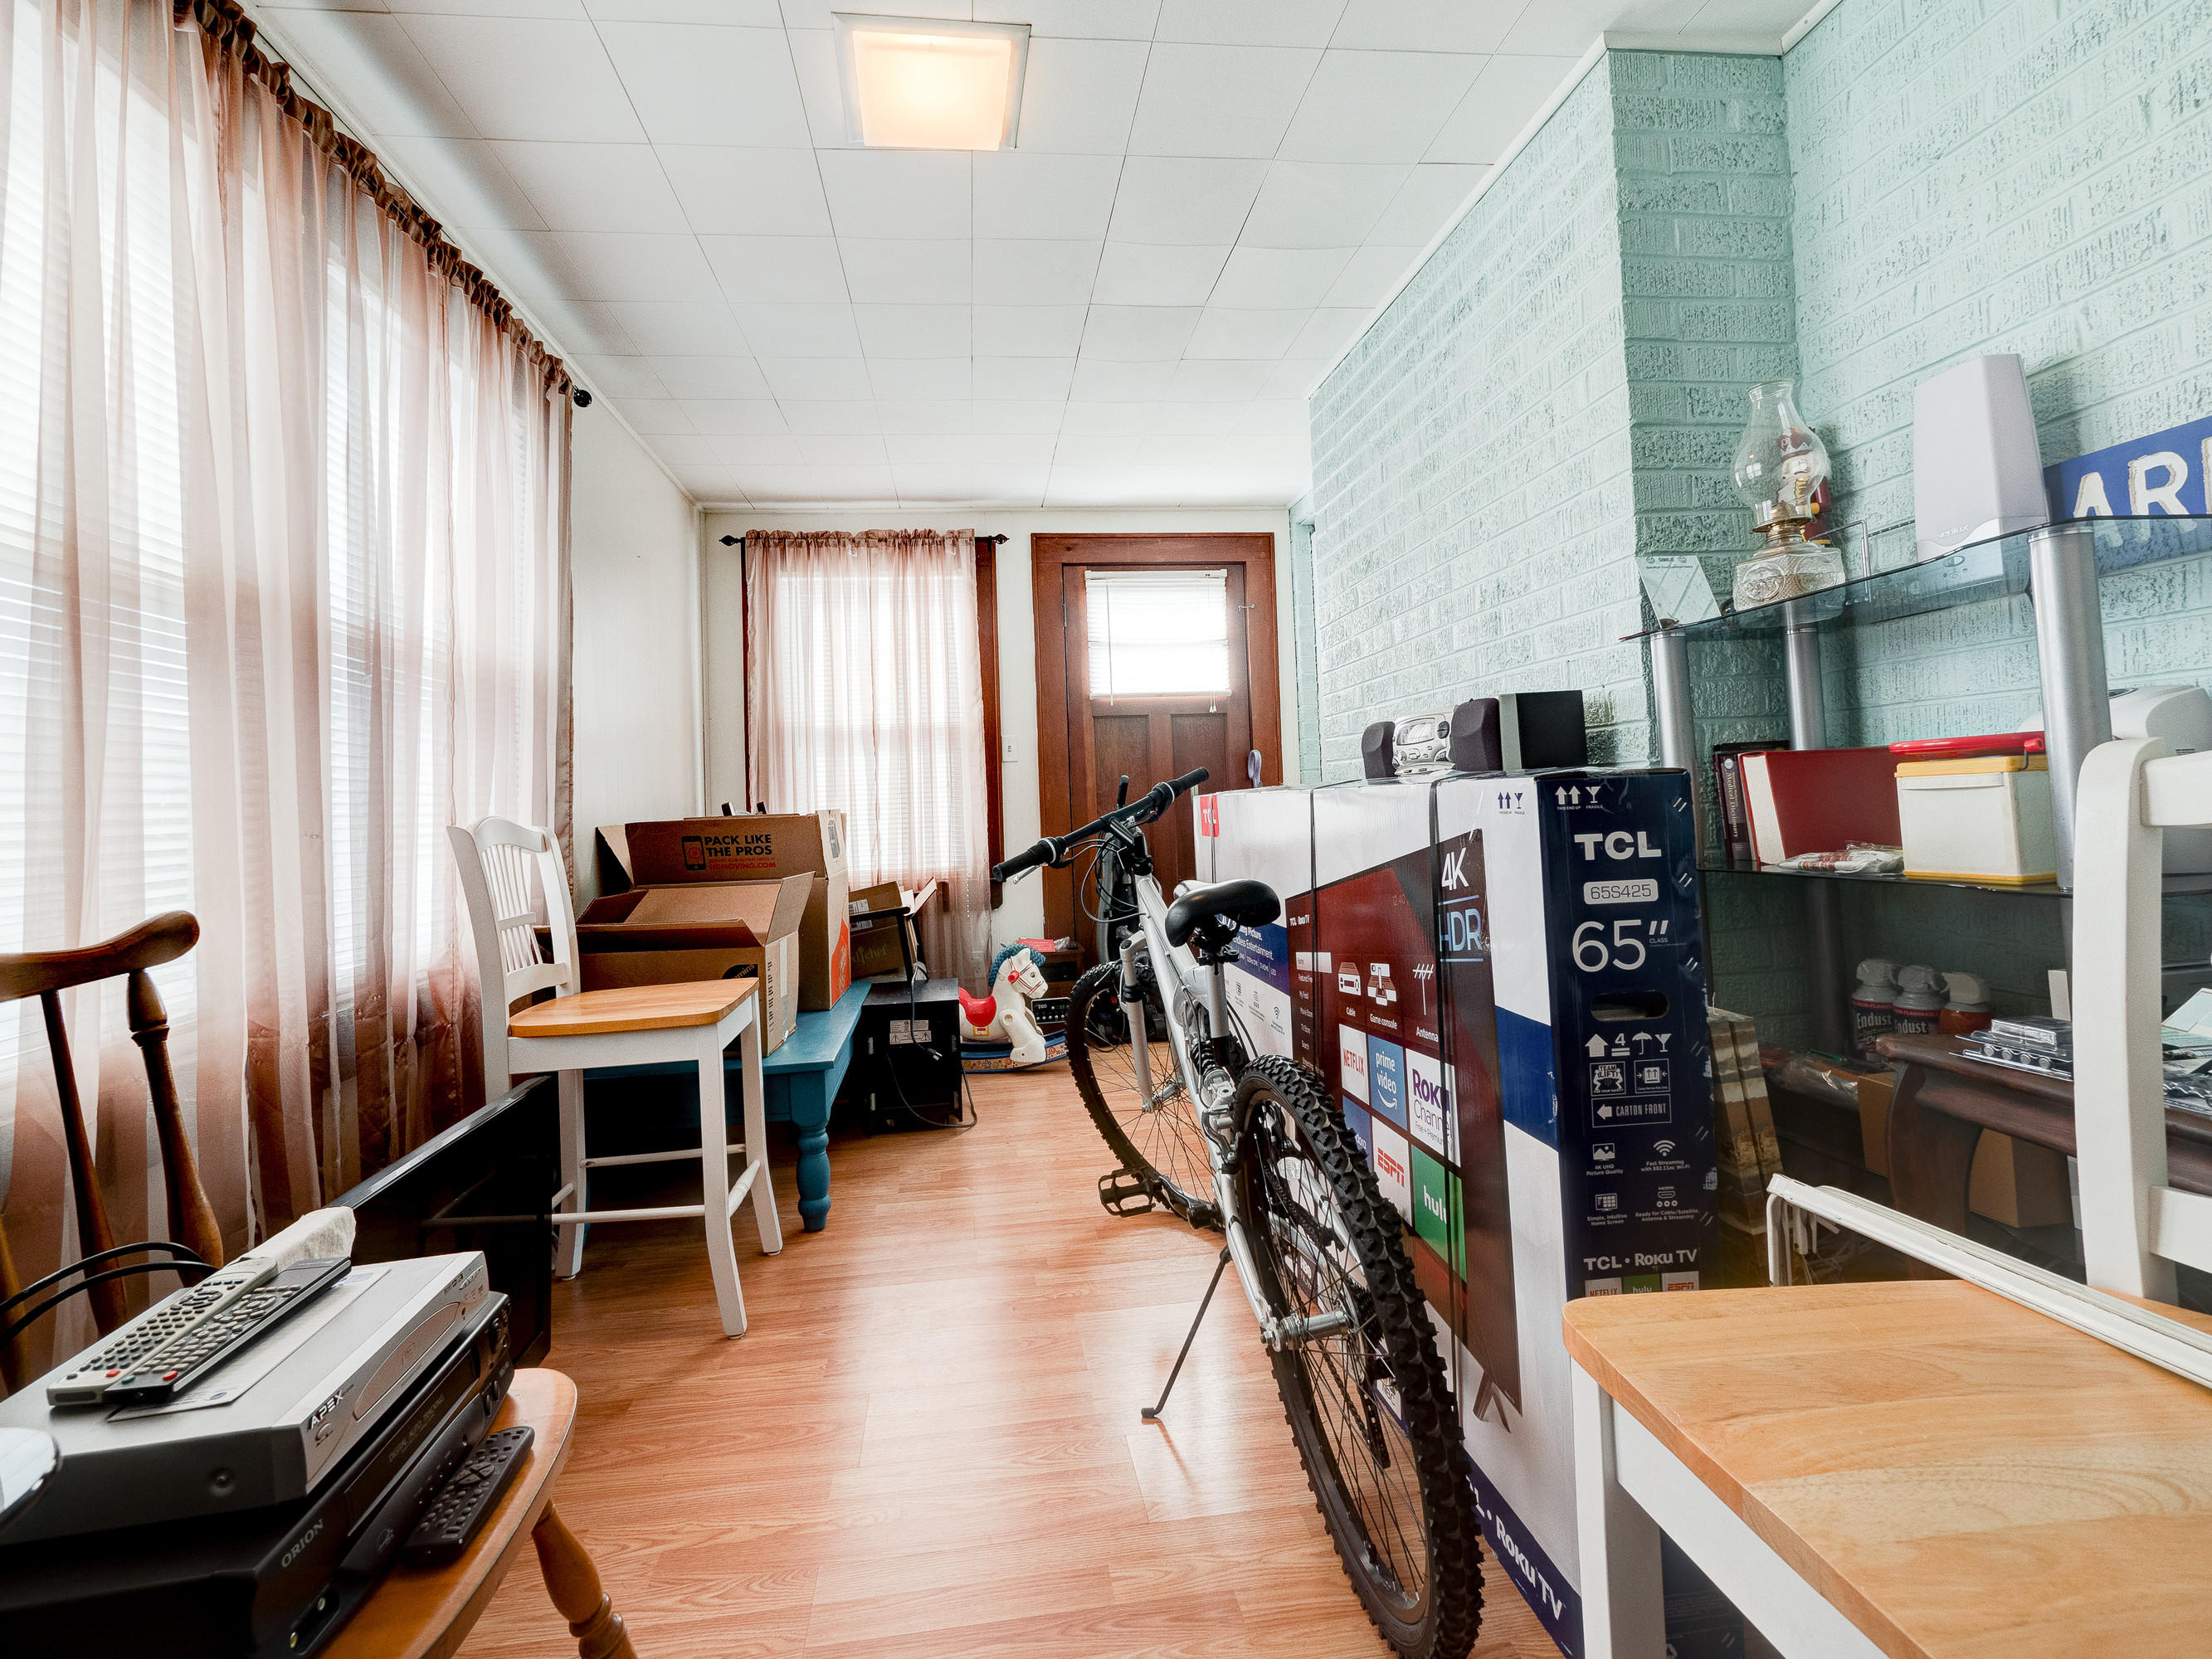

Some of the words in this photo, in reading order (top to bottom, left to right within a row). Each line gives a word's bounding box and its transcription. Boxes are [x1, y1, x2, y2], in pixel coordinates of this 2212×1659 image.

[2073, 437, 2212, 539] AR
[1726, 772, 1735, 799] Medical
[1730, 800, 1738, 838] Dictionary
[704, 835, 740, 845] PACK
[744, 834, 772, 844] LIKE
[706, 847, 732, 857] THE
[736, 845, 772, 856] PROS
[1574, 830, 1661, 860] TCL
[1441, 847, 1469, 891] 4K
[1591, 883, 1652, 900] 65S425
[1439, 908, 1483, 952] HDR
[1246, 939, 1274, 961] Entertainment.
[1346, 1006, 1356, 1017] Cable
[1370, 1013, 1381, 1025] Game
[1381, 1018, 1398, 1029] console
[1857, 1012, 1893, 1029] Endust
[1416, 1026, 1440, 1043] Antenna
[1343, 1048, 1365, 1077] NETFLIX
[1375, 1050, 1396, 1072] prime
[1376, 1070, 1397, 1094] video
[1615, 1104, 1643, 1117] CARTON
[1644, 1103, 1667, 1115] FRONT
[1377, 1147, 1405, 1189] ESPN
[1583, 1256, 1622, 1271] TCL
[1635, 1253, 1674, 1267] Roku
[1676, 1248, 1698, 1262] TV
[1590, 1287, 1618, 1297] NETFLIX
[1668, 1282, 1694, 1291] ESPN
[310, 1389, 344, 1430] APEX
[281, 1519, 324, 1568] ORION
[1496, 1515, 1536, 1588] Roku
[1537, 1570, 1563, 1620] TV
